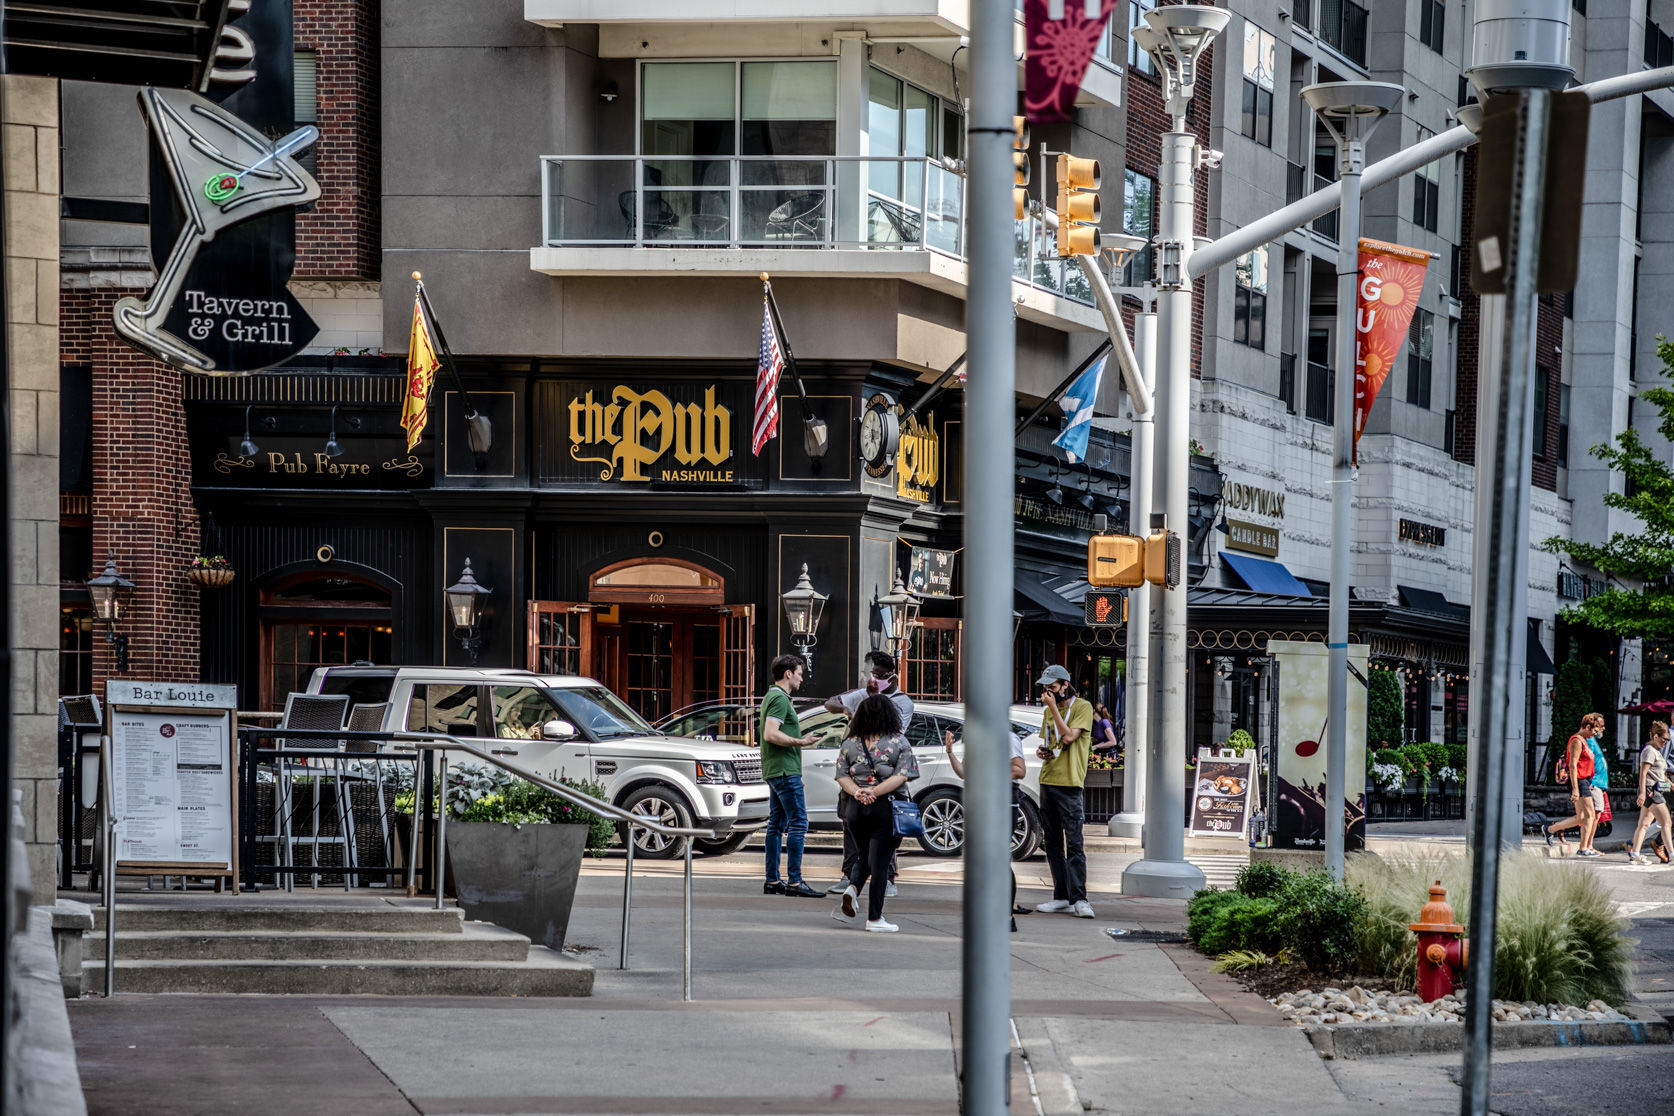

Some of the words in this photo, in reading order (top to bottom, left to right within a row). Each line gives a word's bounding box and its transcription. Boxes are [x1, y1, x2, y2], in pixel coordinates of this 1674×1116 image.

[1366, 258, 1383, 269] the
[185, 290, 291, 318] Tavern
[188, 317, 214, 340] &
[222, 319, 293, 345] Grill
[567, 390, 622, 446] the
[612, 384, 731, 482] Pub
[267, 452, 308, 473] Pub
[314, 452, 370, 478] Fayre
[662, 470, 733, 482] NASHVILLE
[1222, 481, 1285, 519] ADDYWAX
[1231, 526, 1261, 546] CANDLE
[1262, 533, 1277, 549] BAR
[648, 593, 665, 603] 400
[133, 687, 163, 700] Bar
[167, 688, 215, 702] Louie
